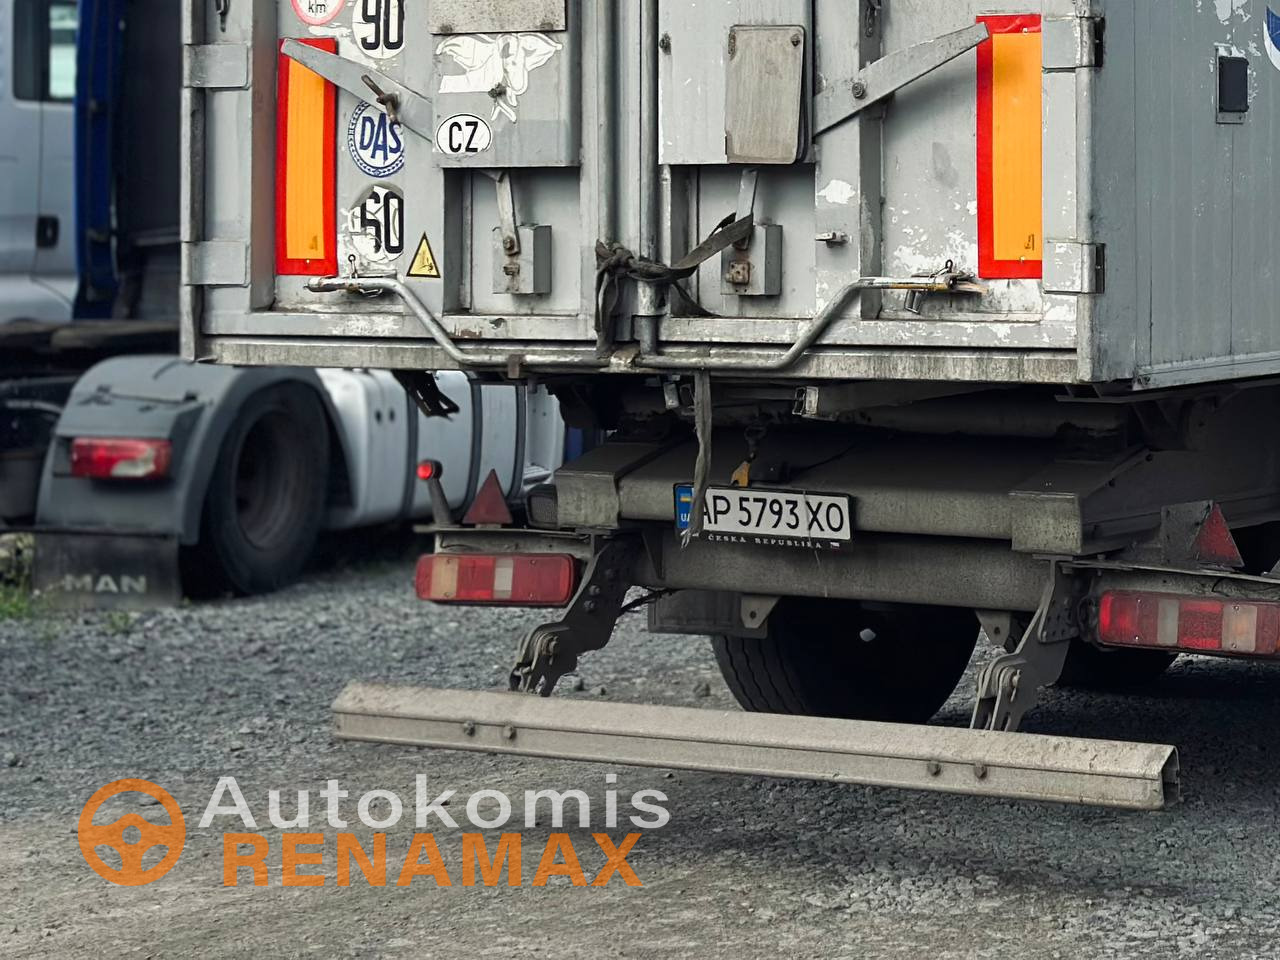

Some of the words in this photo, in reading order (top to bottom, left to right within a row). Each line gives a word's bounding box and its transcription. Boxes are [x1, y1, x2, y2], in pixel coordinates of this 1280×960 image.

[308, 0, 327, 14] km
[359, 112, 402, 160] DAS
[448, 121, 479, 153] CZ
[738, 497, 799, 529] 5793
[806, 501, 844, 532] XO
[755, 538, 822, 549] REPUBLIKA
[63, 574, 148, 593] MAN
